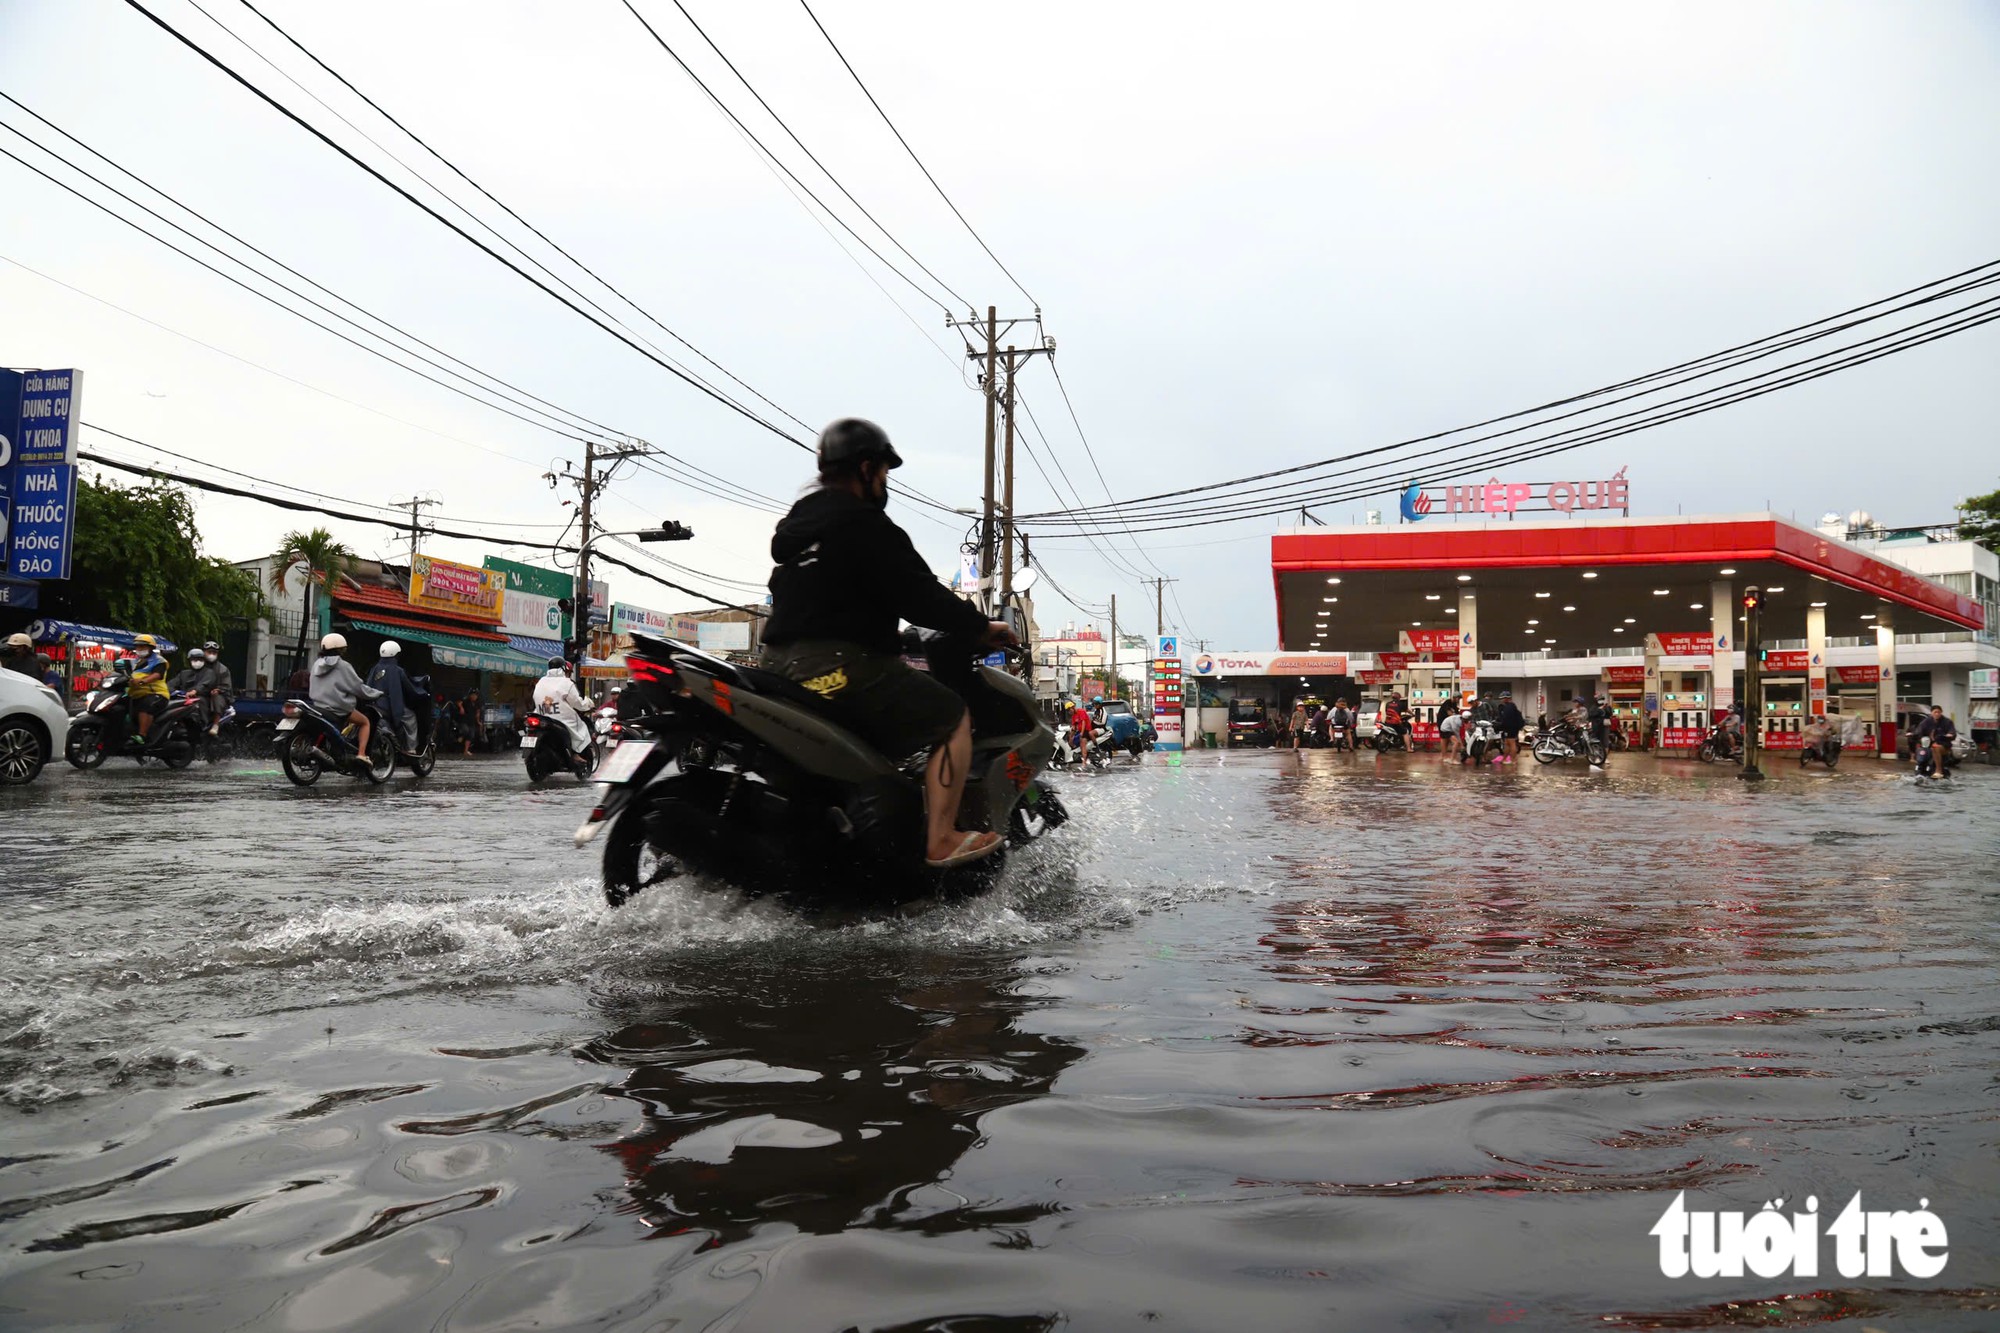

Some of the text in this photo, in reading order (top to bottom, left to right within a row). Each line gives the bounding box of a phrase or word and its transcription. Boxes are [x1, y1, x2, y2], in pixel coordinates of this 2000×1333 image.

[26, 374, 70, 392] CỬA HÀNG
[23, 398, 69, 422] DỤNG CỤ
[25, 428, 62, 448] Y KHOA
[25, 468, 58, 491] NHÀ
[1445, 465, 1628, 519] HIỆP QUẾ
[16, 499, 64, 523] THUỐC
[14, 530, 60, 551] HỒNG
[19, 555, 53, 574] ĐÀO
[548, 611, 559, 626] 15K
[646, 612, 651, 625] 9
[1218, 658, 1262, 669] TOTAL
